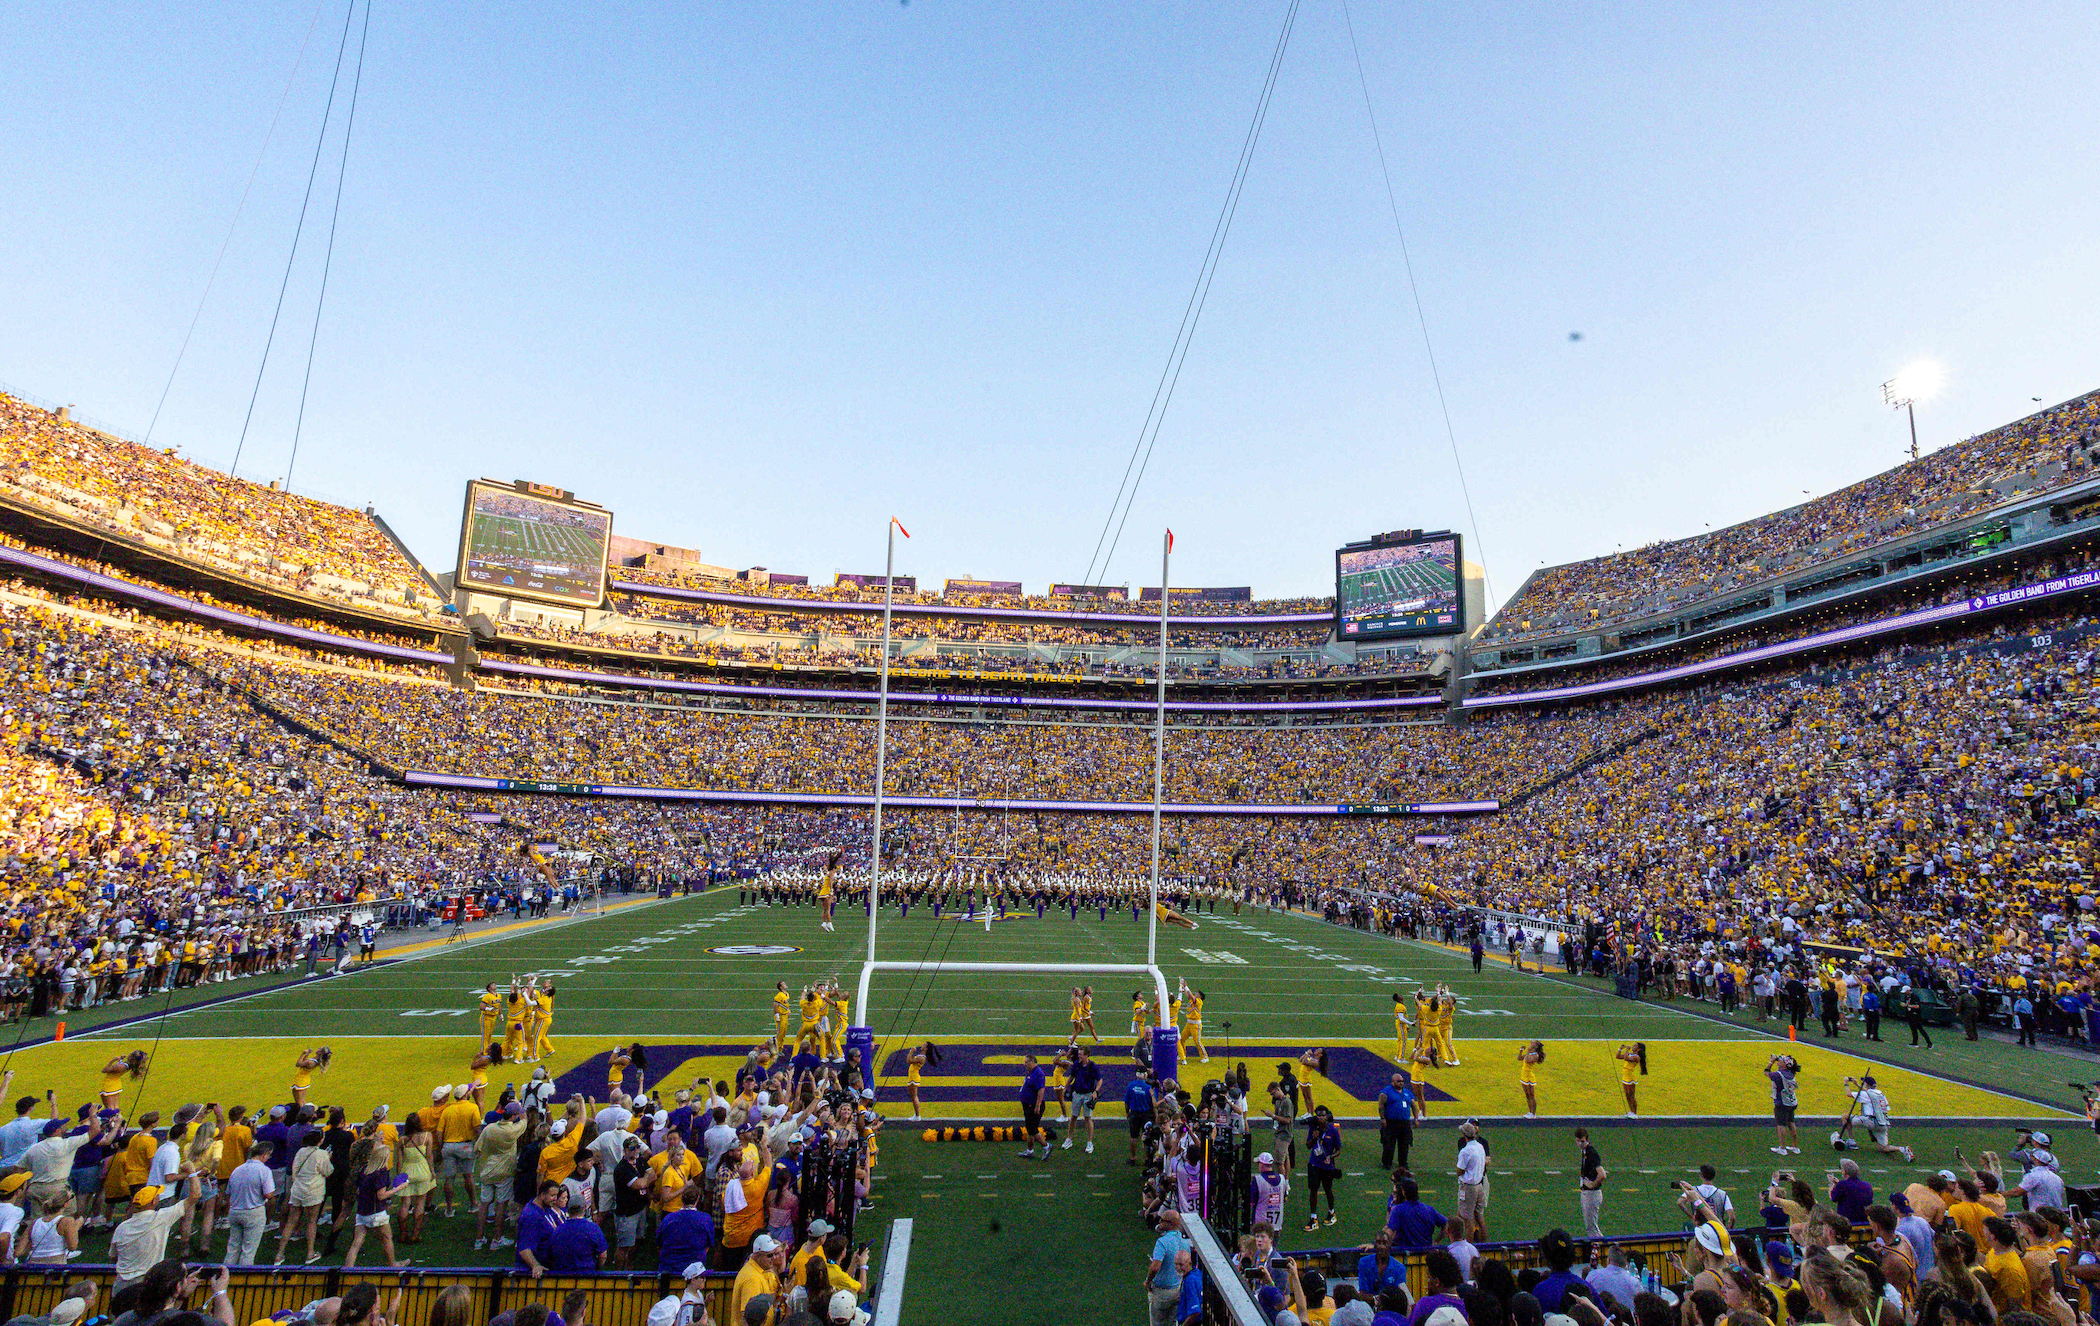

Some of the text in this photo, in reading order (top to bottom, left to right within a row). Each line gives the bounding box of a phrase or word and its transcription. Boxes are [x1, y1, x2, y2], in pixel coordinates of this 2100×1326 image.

[528, 480, 563, 499] LSU
[1381, 529, 1412, 542] LSU
[554, 585, 569, 593] COX
[1986, 596, 1999, 606] THE
[1999, 588, 2026, 603] GOLDEN
[2025, 584, 2045, 597] BAND
[2046, 579, 2067, 592] FROM
[2031, 634, 2053, 648] 103
[876, 666, 1084, 684] WELCOME TO DEATH VALLEY
[1790, 680, 1802, 689] 101
[1266, 1211, 1281, 1224] 57
